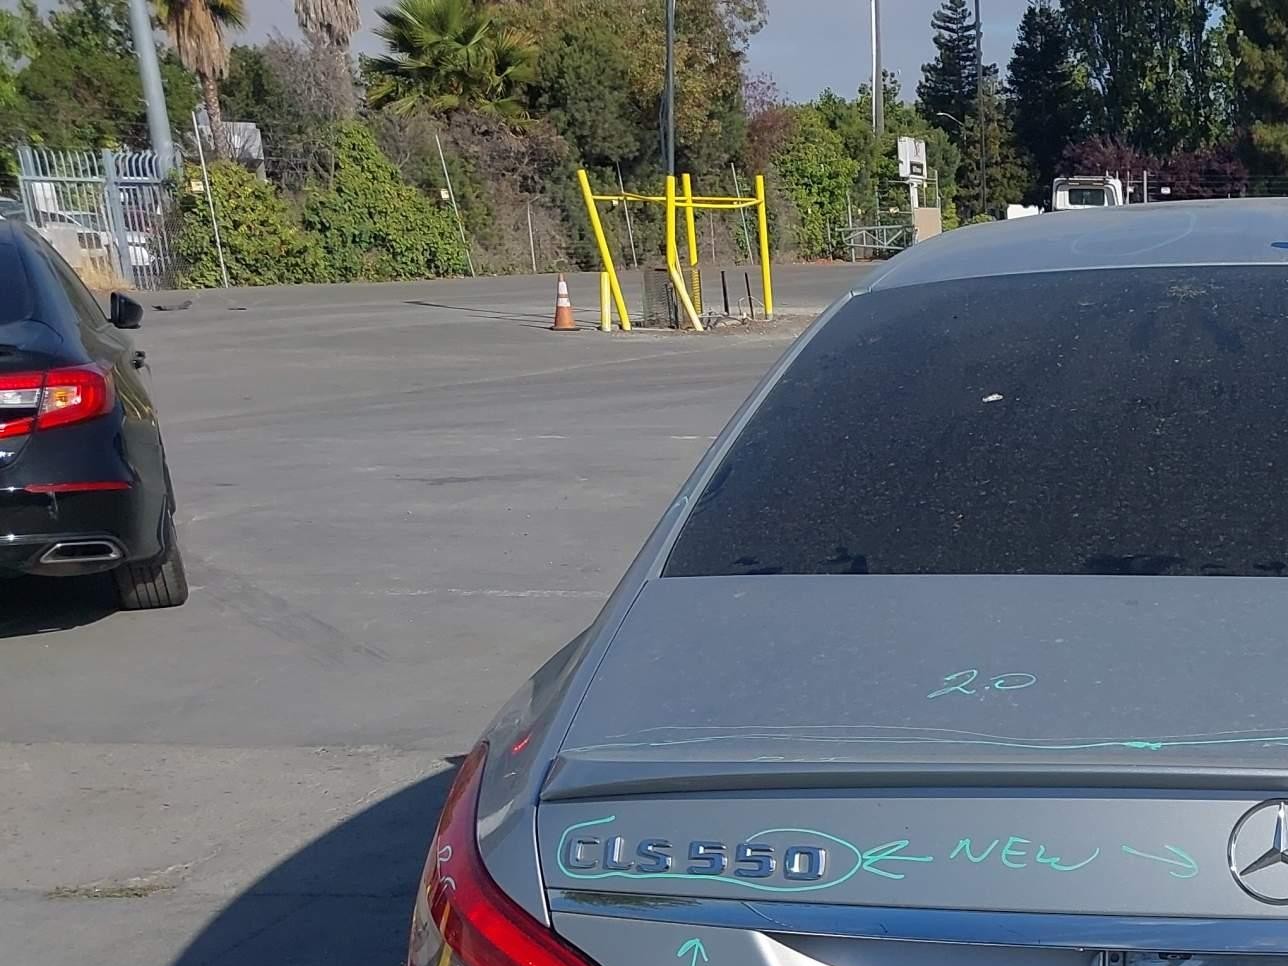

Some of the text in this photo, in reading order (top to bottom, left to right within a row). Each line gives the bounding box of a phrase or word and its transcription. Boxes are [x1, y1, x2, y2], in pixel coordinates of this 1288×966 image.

[926, 669, 1037, 699] 2.0
[569, 836, 828, 882] CLS 550
[949, 836, 1101, 871] NEW
